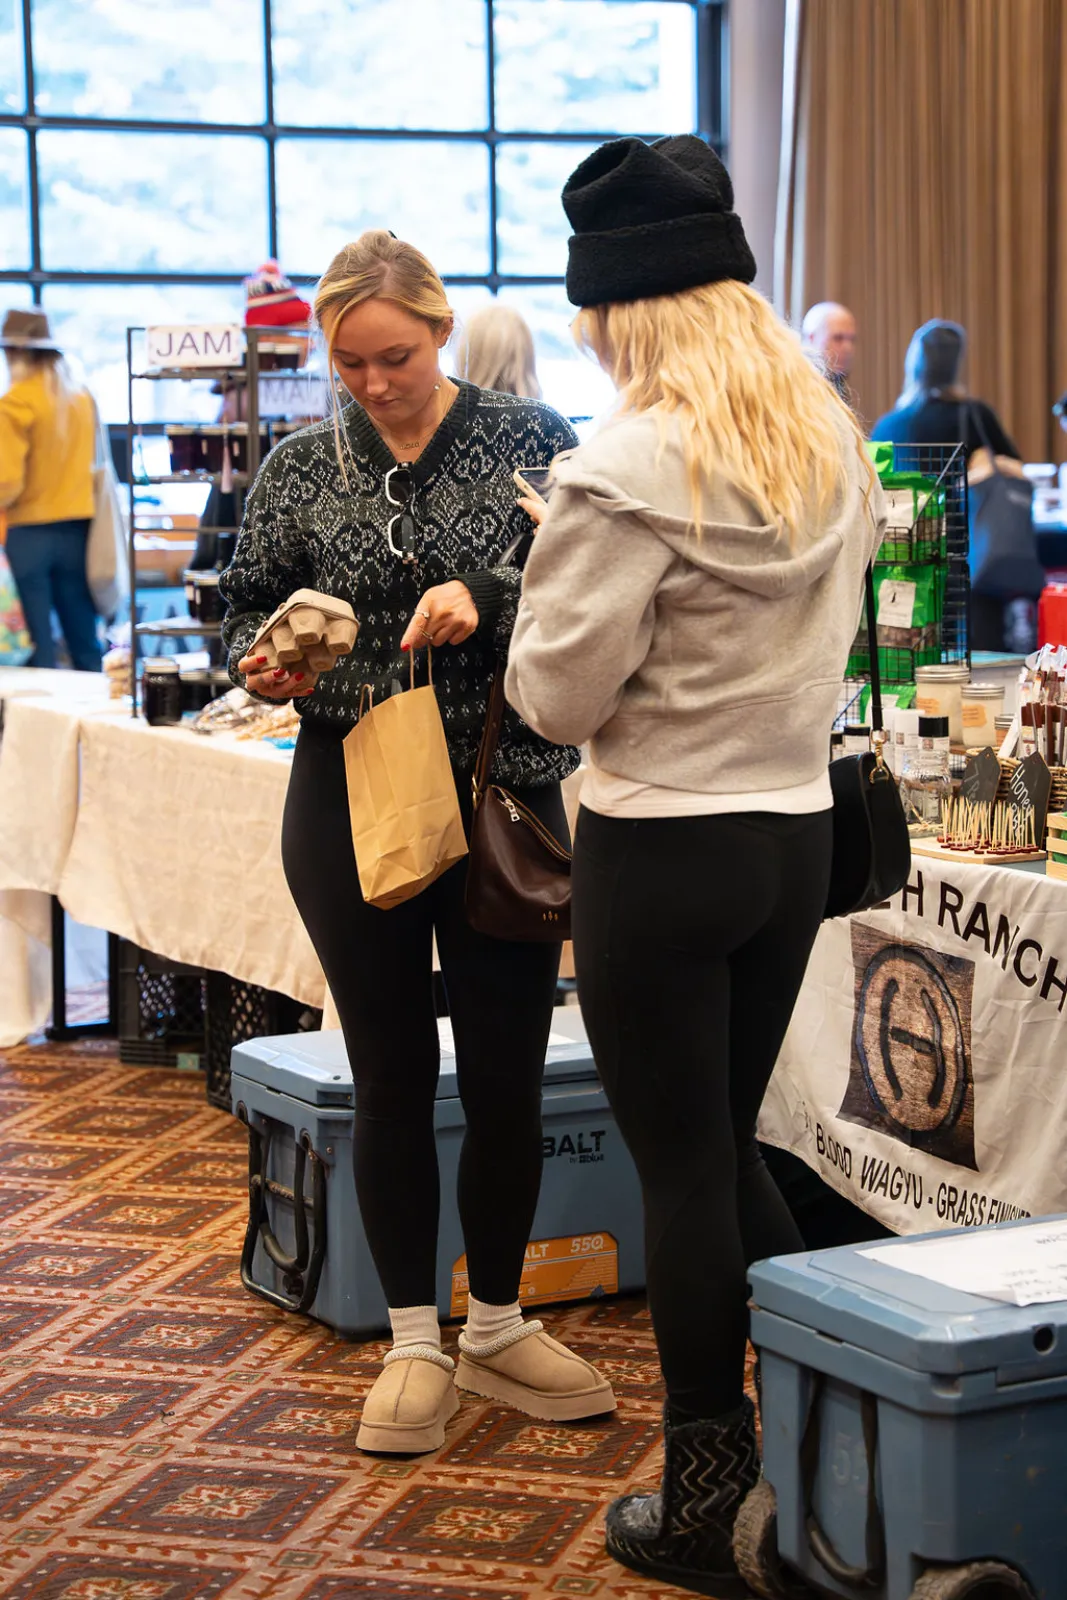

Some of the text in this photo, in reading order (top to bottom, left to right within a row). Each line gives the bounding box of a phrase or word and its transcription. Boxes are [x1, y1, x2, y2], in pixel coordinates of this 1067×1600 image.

[156, 330, 232, 358] JAM
[937, 880, 1067, 1013] RANCH
[860, 1154, 924, 1210] WAGYU
[936, 1182, 987, 1227] GRASS
